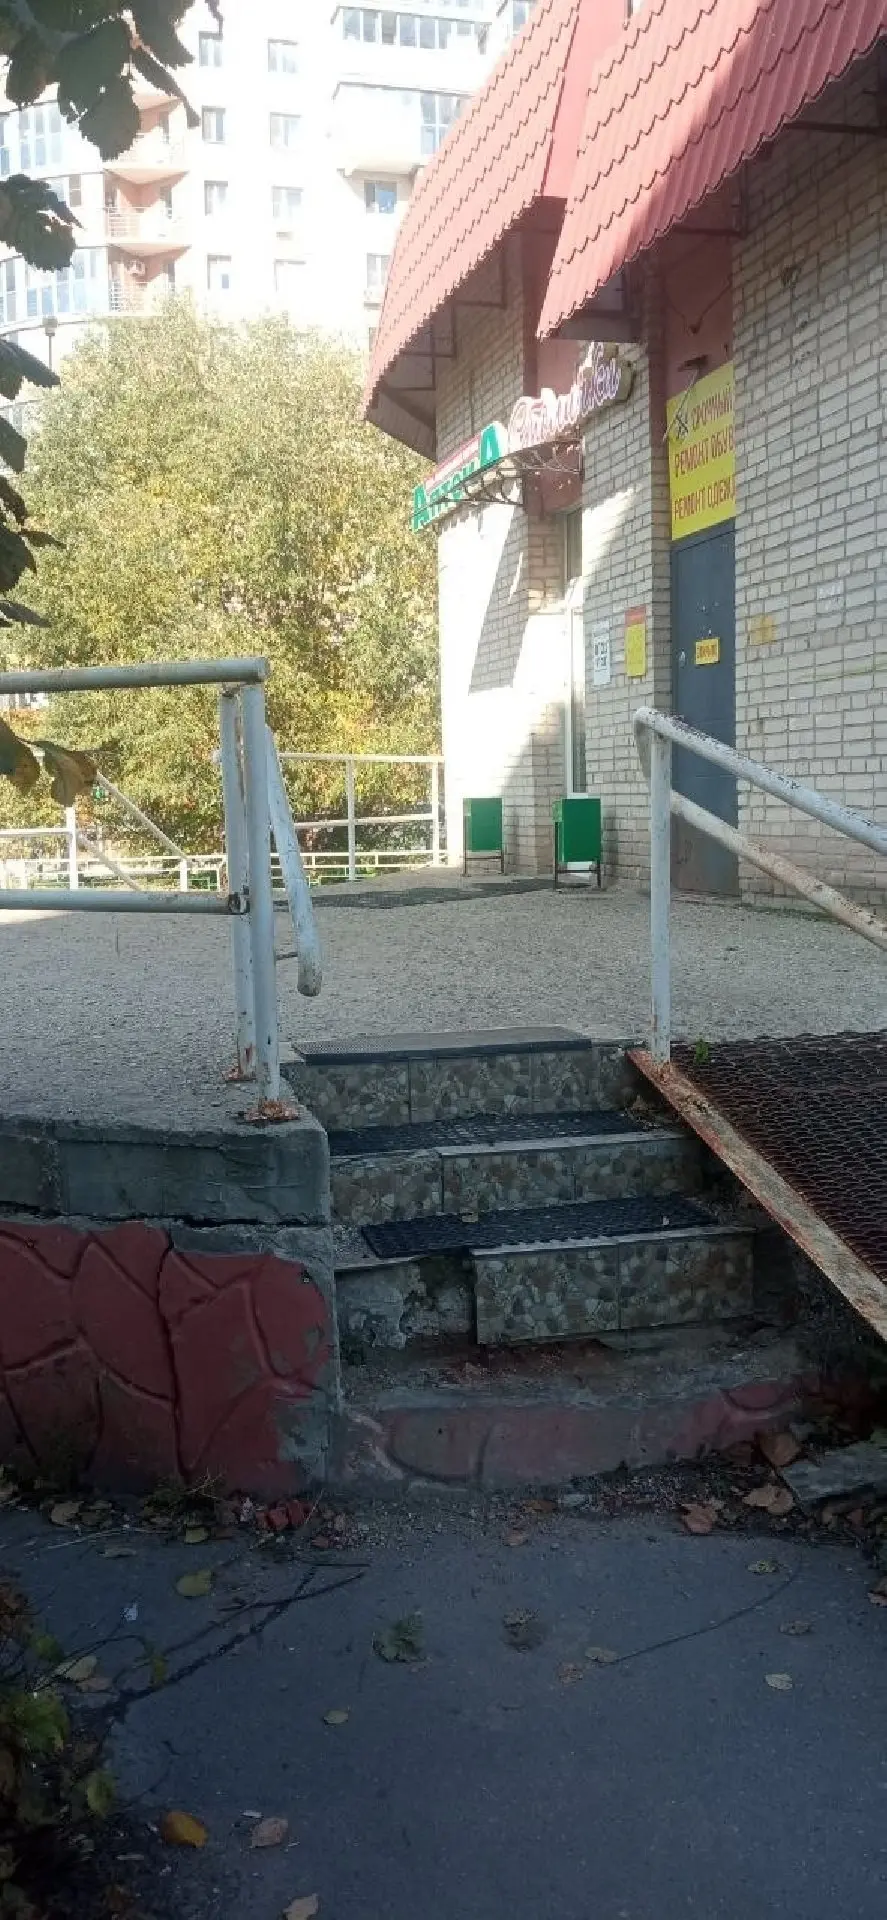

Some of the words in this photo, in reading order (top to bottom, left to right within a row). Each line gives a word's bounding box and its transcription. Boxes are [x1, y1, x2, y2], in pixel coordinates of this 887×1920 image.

[675, 438, 709, 477] РЕМОНТ
[711, 424, 736, 457] ОБУВ
[674, 486, 706, 521] РЕМОНТ
